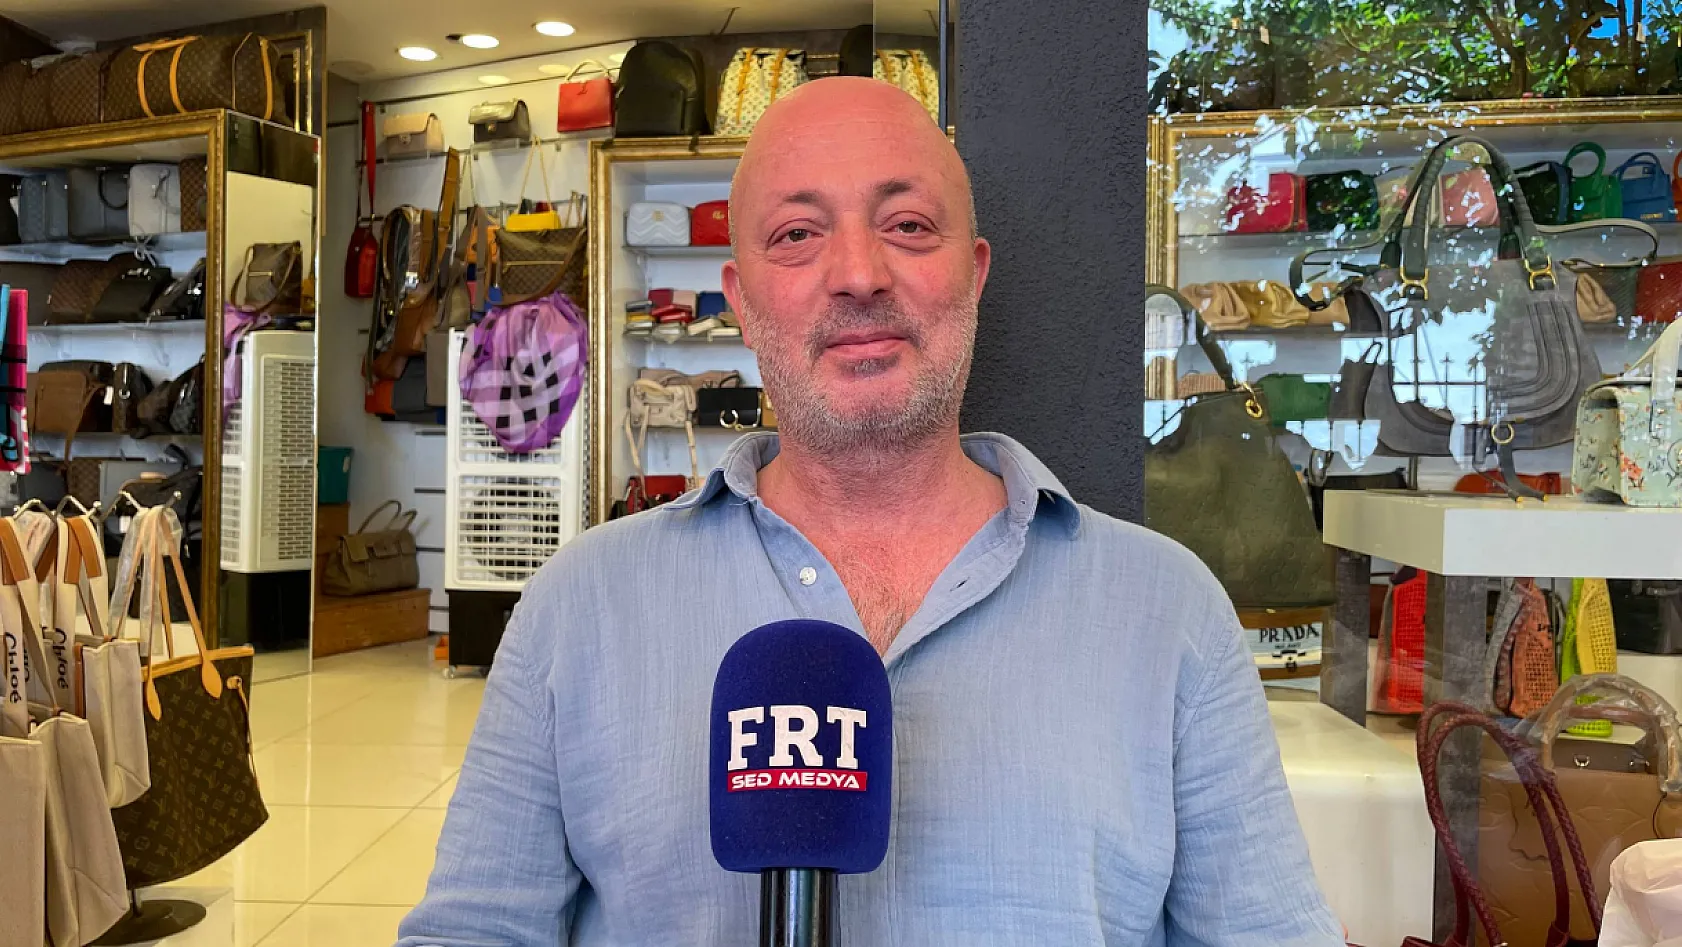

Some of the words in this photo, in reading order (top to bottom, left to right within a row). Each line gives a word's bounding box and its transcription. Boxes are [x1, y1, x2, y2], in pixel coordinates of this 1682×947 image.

[1259, 624, 1319, 642] PRADA
[727, 705, 867, 771] FRT
[731, 773, 772, 789] SED
[778, 772, 860, 788] MEDYA
